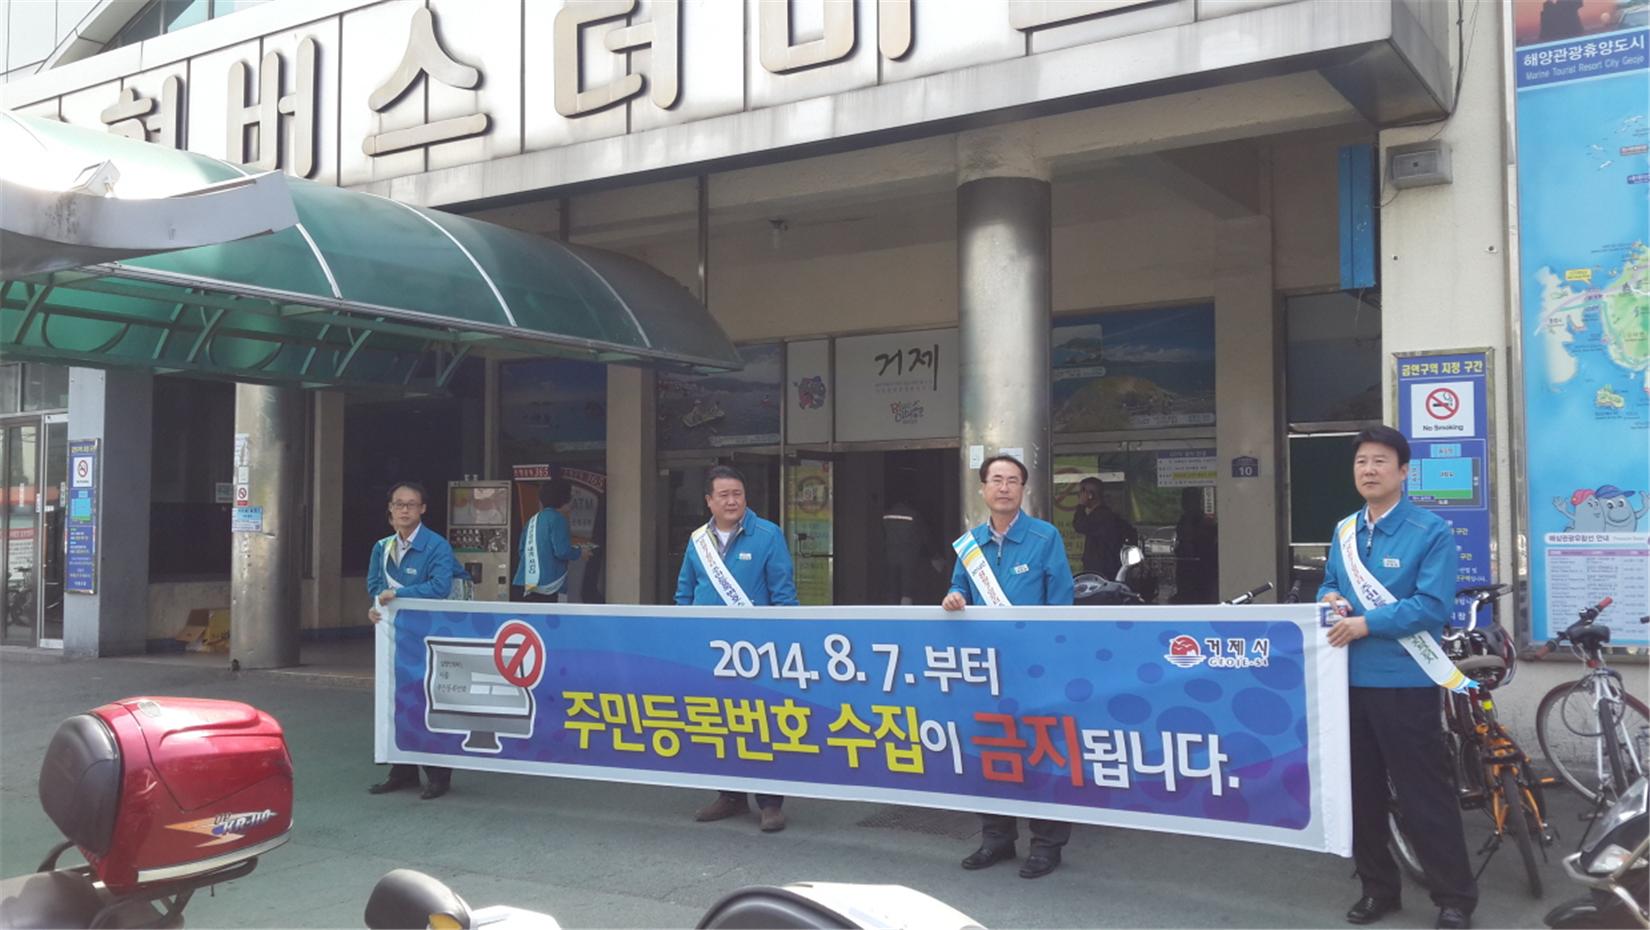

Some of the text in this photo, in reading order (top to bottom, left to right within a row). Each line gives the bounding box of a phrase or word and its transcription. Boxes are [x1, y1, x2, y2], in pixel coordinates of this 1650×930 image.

[1523, 35, 1645, 66] 해양관광휴양도시
[1526, 55, 1645, 80] Marine Tourist Resort City Geoje
[875, 344, 939, 391] 거제
[1402, 360, 1483, 377] 금연구역 지정 구간
[1434, 424, 1464, 432] Smoking
[1239, 466, 1252, 476] 10
[1205, 638, 1269, 657] 거제시
[709, 634, 1000, 696] 2014. 8. 7. 부터
[562, 689, 1240, 796] 주민등록번호 수집이 금지됩니다.
